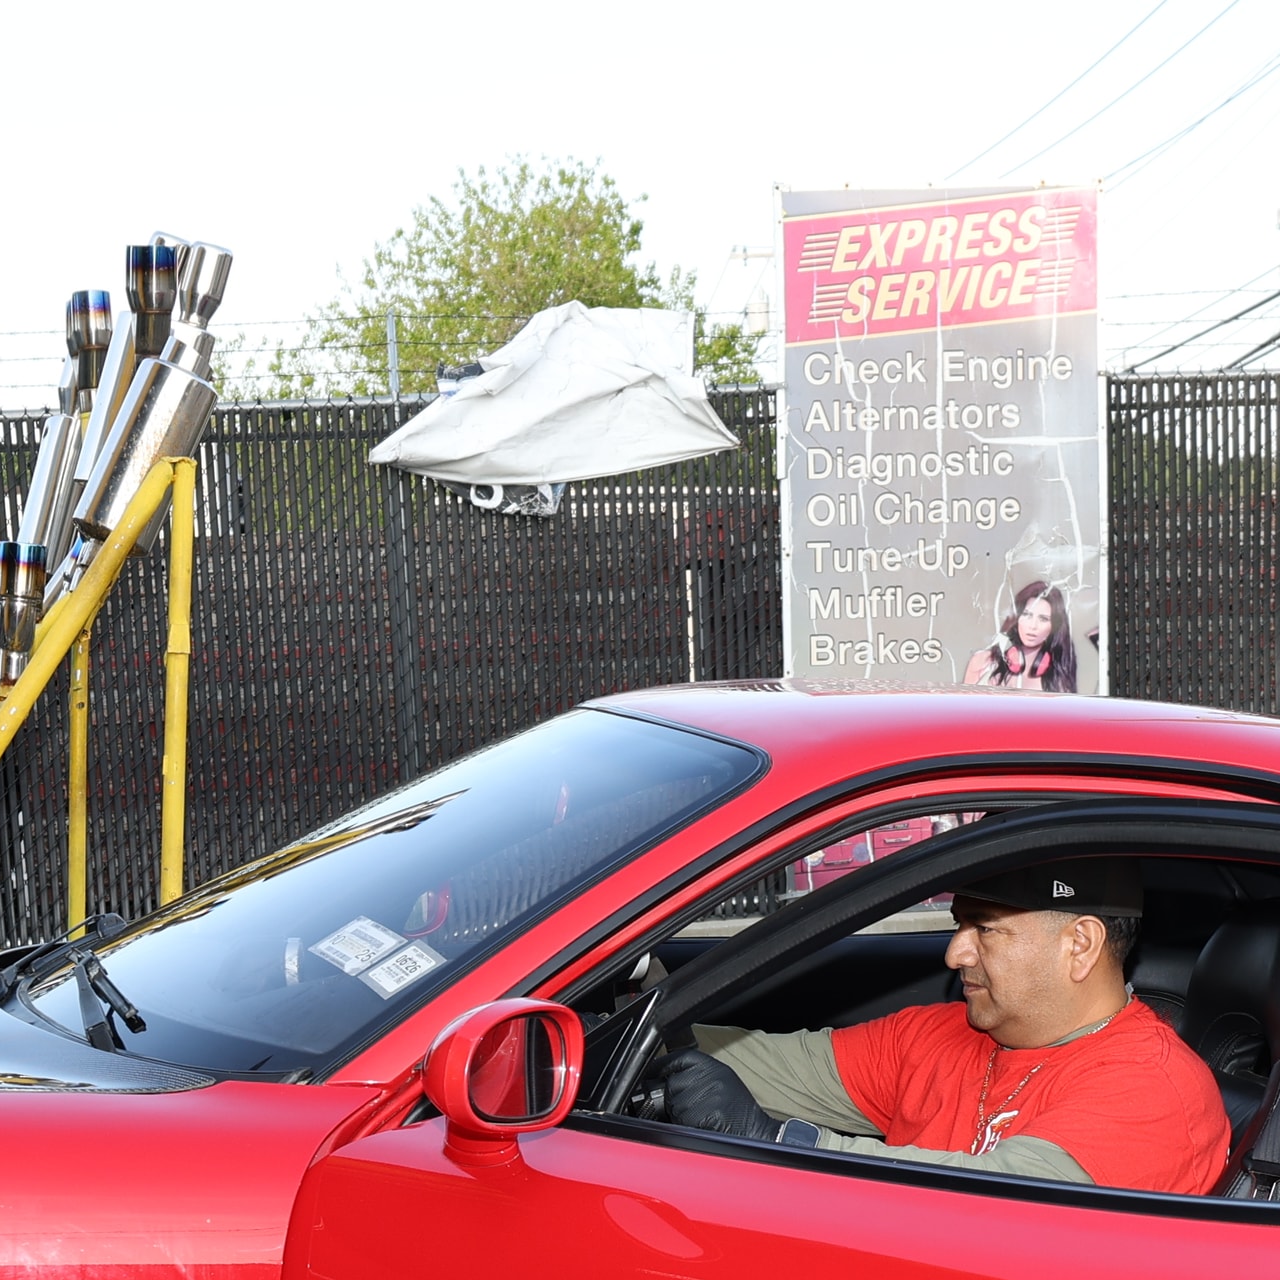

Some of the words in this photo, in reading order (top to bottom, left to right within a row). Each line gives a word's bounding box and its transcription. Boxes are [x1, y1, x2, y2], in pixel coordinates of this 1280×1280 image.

[831, 204, 1046, 274] EXPRESS
[841, 257, 1042, 325] SERVICE
[803, 349, 928, 387] Check
[942, 348, 1074, 389] Engine
[805, 398, 1021, 433] Alternators
[807, 444, 1015, 486] Diagnostic
[807, 493, 859, 527] Oil
[873, 492, 1021, 531] Change
[807, 541, 902, 573] Tune
[918, 539, 971, 578] Up
[809, 585, 945, 620] Muffler
[809, 634, 944, 668] Brakes
